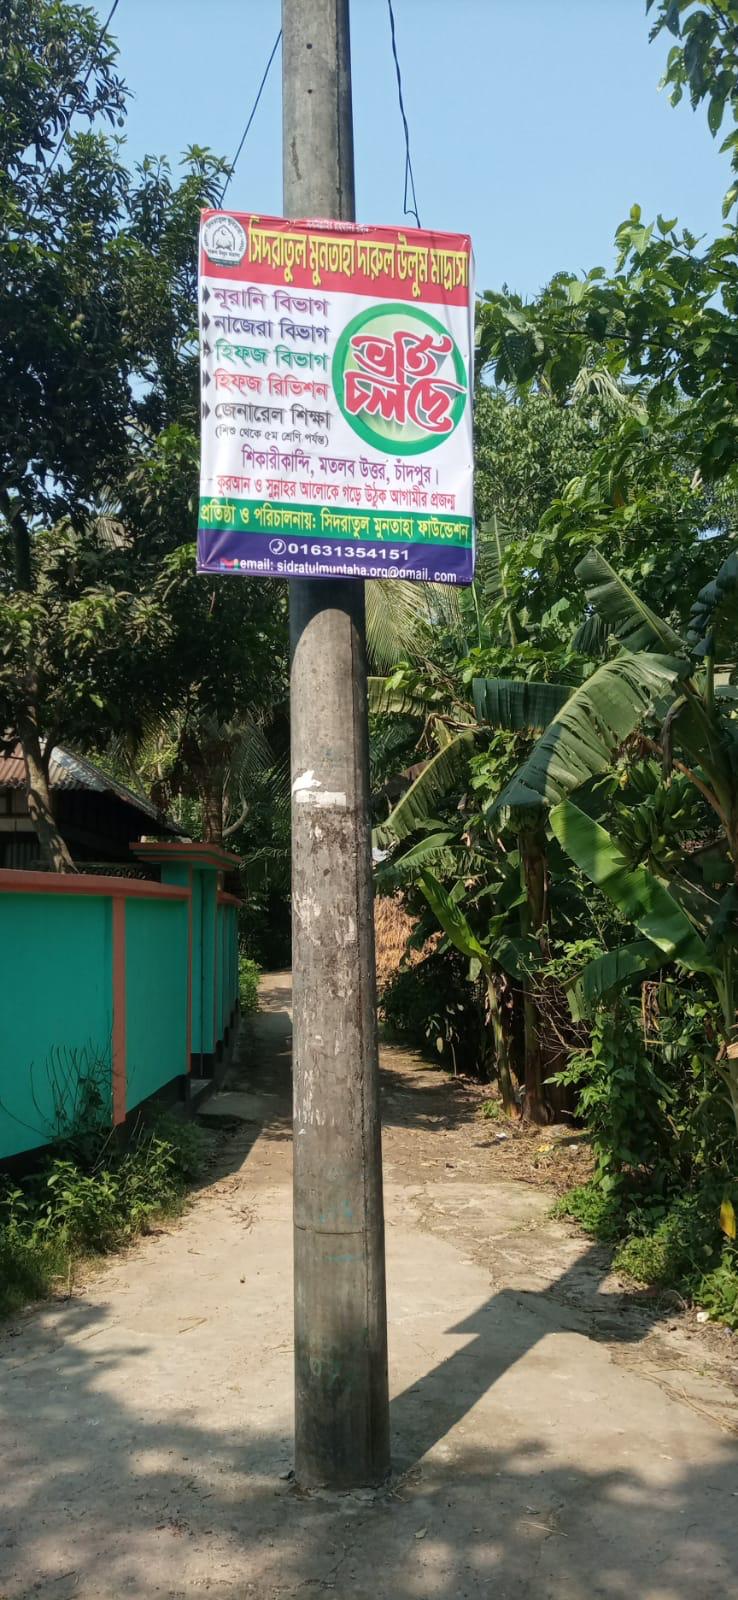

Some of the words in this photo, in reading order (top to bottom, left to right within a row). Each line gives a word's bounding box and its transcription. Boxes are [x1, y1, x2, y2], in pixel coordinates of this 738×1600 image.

[248, 215, 307, 283] সিদরাতুল
[308, 235, 355, 287] মুনতাহা
[357, 239, 395, 280] দারুল
[396, 232, 429, 297] উলুম
[430, 247, 469, 291] মাদ্রাসা
[212, 286, 267, 312] নূরানি
[272, 290, 331, 317] বিভাগ
[213, 314, 273, 338] নাজেরা
[278, 317, 331, 344] বিভাগ
[272, 344, 331, 372] বিভাগ
[350, 330, 453, 384] ভর্তি
[267, 372, 331, 401] রিভিশন
[215, 402, 288, 425] জেনারেল
[290, 403, 333, 430] শিক্ষা
[344, 371, 466, 434] চলছে
[239, 427, 261, 439] থেকে
[319, 456, 355, 478] মতলব
[216, 474, 251, 496] কুরআন
[255, 479, 263, 493] ও
[300, 480, 340, 500] আলোকে
[342, 484, 362, 506] গড়ে
[365, 481, 387, 508] উঠুক
[390, 485, 428, 508] আগামীর
[431, 491, 456, 511] প্রজন্ম
[200, 498, 236, 526] প্রতিষ্ঠা
[240, 507, 250, 524] ও
[320, 507, 370, 539] সিদরাতুল
[373, 516, 414, 540] মুনতাহা
[417, 514, 470, 544] ফাউন্ডেশন
[288, 542, 409, 561] 01631354151
[240, 558, 273, 571] email:
[434, 571, 457, 583] com
